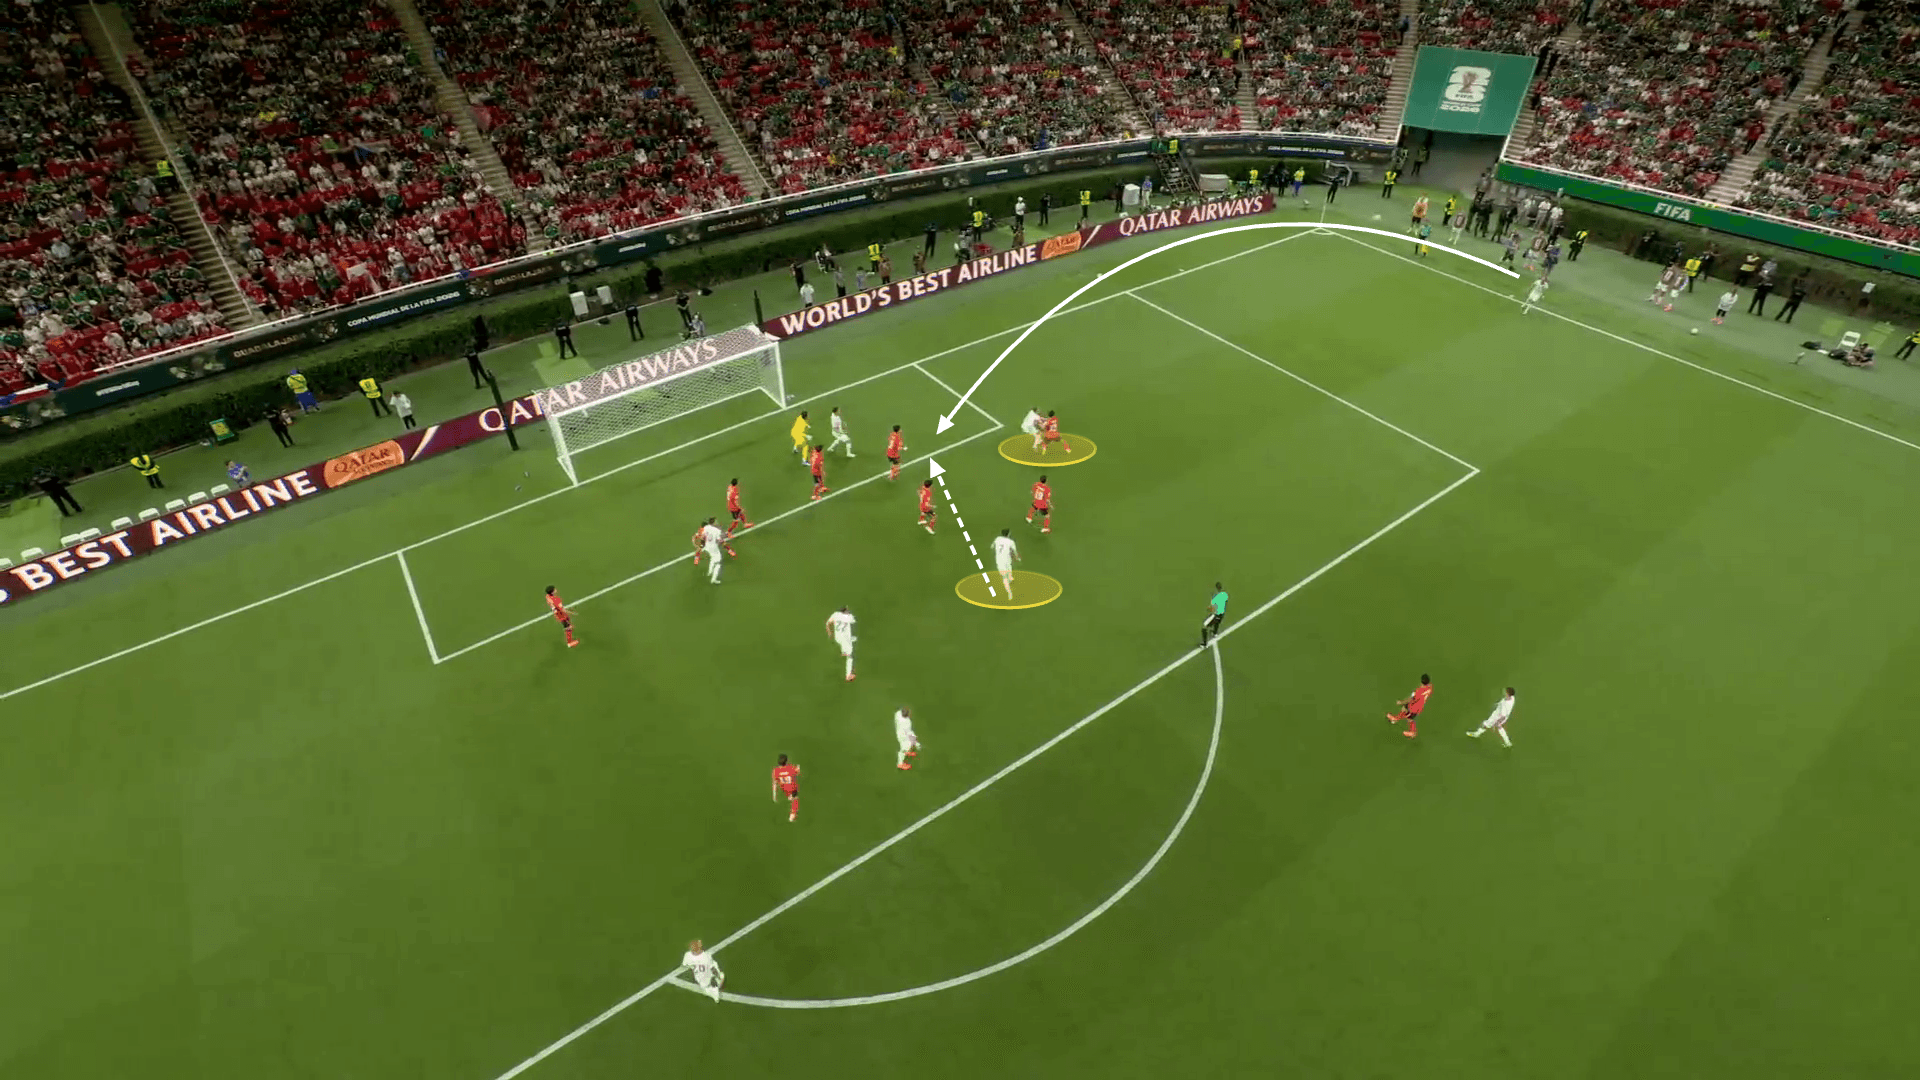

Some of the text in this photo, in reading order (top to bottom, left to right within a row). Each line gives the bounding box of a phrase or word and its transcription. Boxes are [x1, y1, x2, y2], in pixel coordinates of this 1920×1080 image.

[1119, 195, 1263, 236] QATAR AIRWAYS
[1653, 202, 1690, 221] FIFA
[347, 317, 368, 327] COPA
[367, 308, 400, 321] MUNDIAL
[400, 304, 411, 312] DE
[419, 298, 436, 307] FIFA
[435, 291, 460, 302] 2026
[780, 244, 1037, 335] WORLD'S BEST AIRLINE
[479, 338, 717, 432] QATAR AIRWAYS
[333, 448, 390, 473] QATAR
[9, 470, 318, 591] BEST AIRLINE
